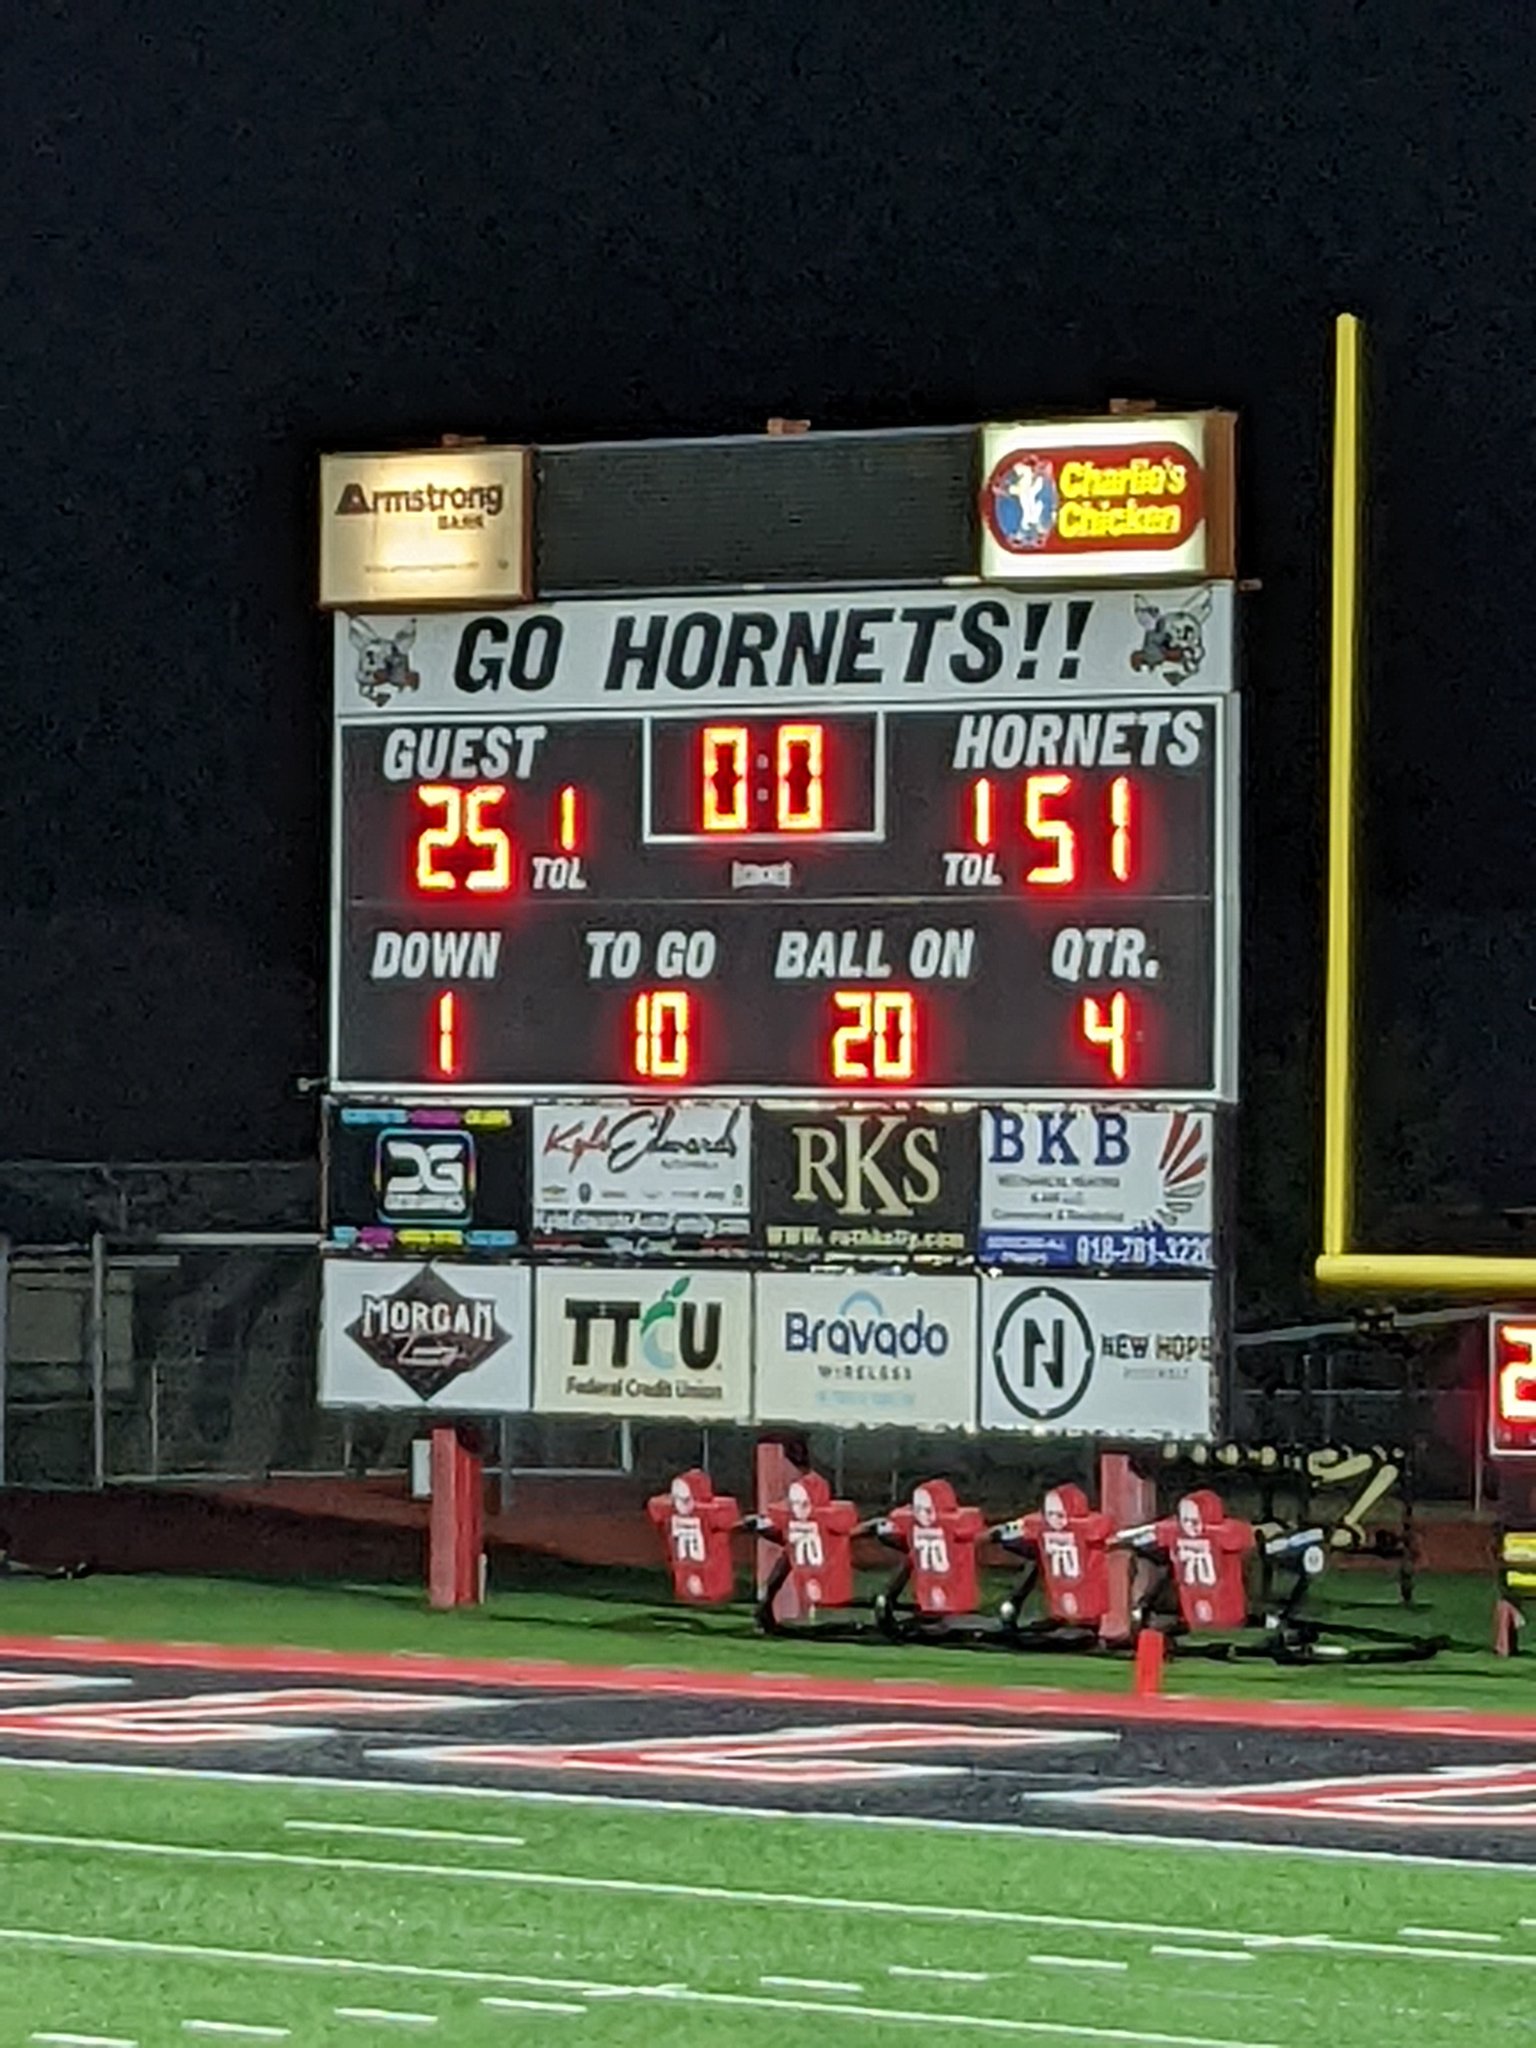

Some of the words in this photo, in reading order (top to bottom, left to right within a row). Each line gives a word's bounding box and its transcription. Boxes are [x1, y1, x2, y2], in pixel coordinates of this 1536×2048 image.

[335, 483, 504, 516] Armstrong
[1060, 457, 1186, 498] Charlie's
[1059, 499, 1181, 537] Chicken
[455, 616, 564, 692] GO
[604, 601, 1093, 692] HORNETS!!
[383, 726, 547, 781] GUEST
[953, 711, 1203, 769] HORNETS
[416, 785, 509, 891] 25
[561, 786, 576, 850] 1
[974, 778, 991, 847] 1
[1026, 774, 1130, 884] 51
[532, 858, 587, 890] TOL
[942, 853, 1002, 887] TOL
[371, 931, 501, 979] DOWN
[586, 931, 641, 979] TO
[656, 930, 716, 978] GO
[774, 930, 892, 979] BALL
[909, 928, 975, 978] ON
[1051, 928, 1159, 982] QTR.
[440, 991, 454, 1075] 1
[635, 991, 688, 1077] 10
[833, 991, 914, 1079] 20
[1083, 991, 1126, 1080] 4
[792, 1115, 940, 1217] RKS
[362, 1298, 494, 1342] MORGAN
[565, 1298, 721, 1371] TTCU
[785, 1309, 948, 1358] Bravado
[1022, 1318, 1065, 1390] N
[565, 1376, 622, 1397] Federal
[625, 1378, 672, 1398] Credit
